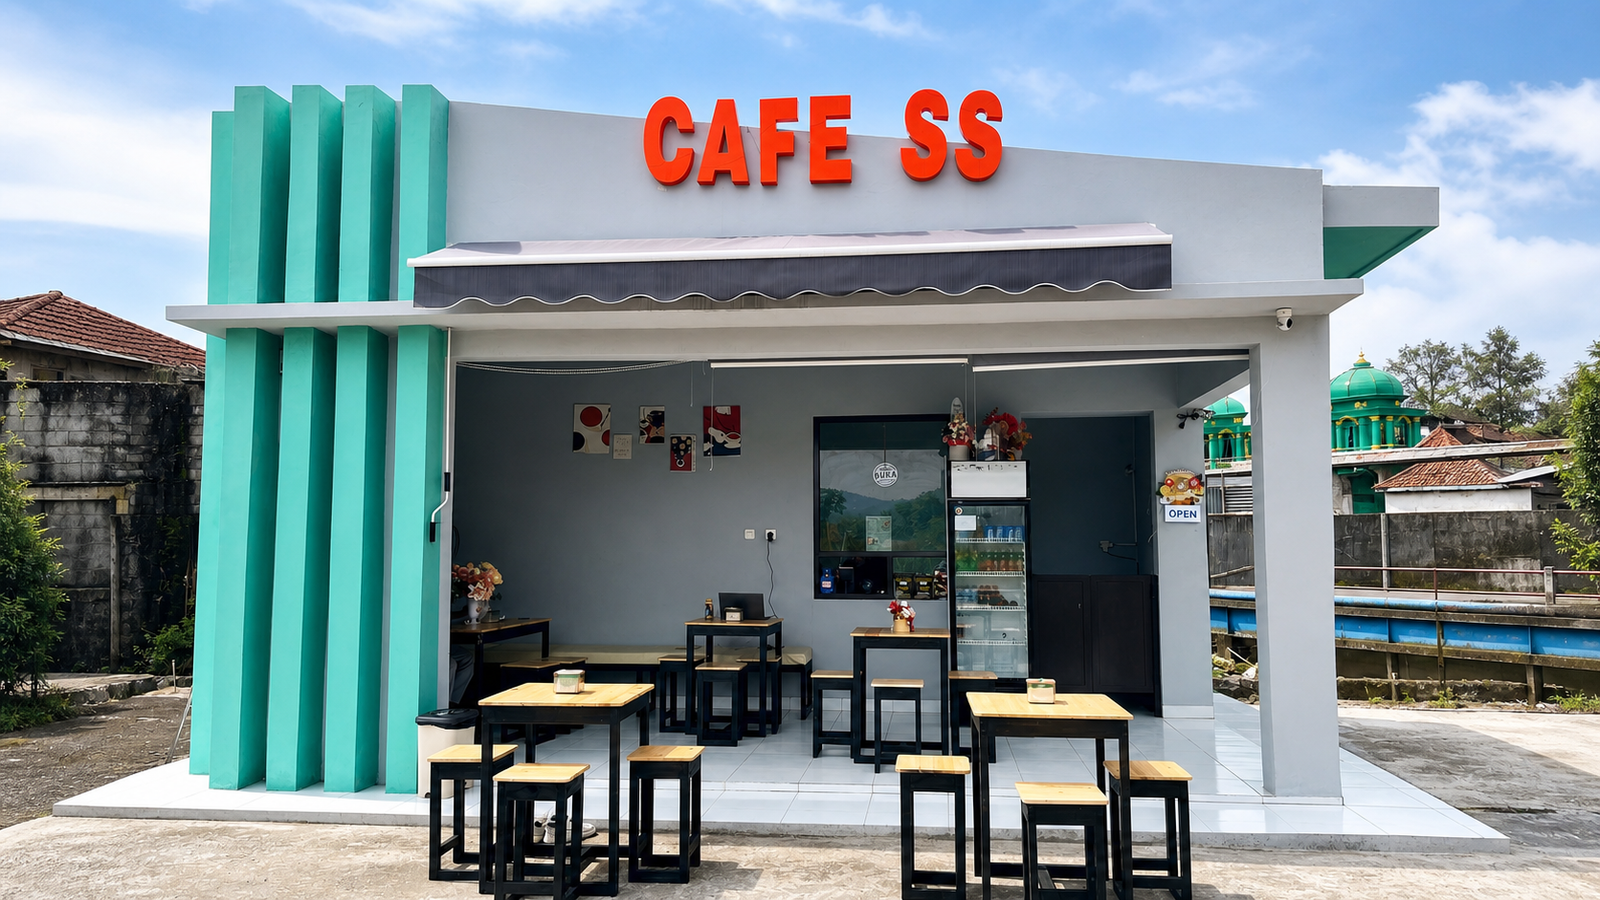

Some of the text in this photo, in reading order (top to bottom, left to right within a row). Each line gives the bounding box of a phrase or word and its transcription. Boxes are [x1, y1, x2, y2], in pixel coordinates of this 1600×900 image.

[643, 88, 1003, 186] CAFE SS
[1168, 509, 1197, 518] OPEN
